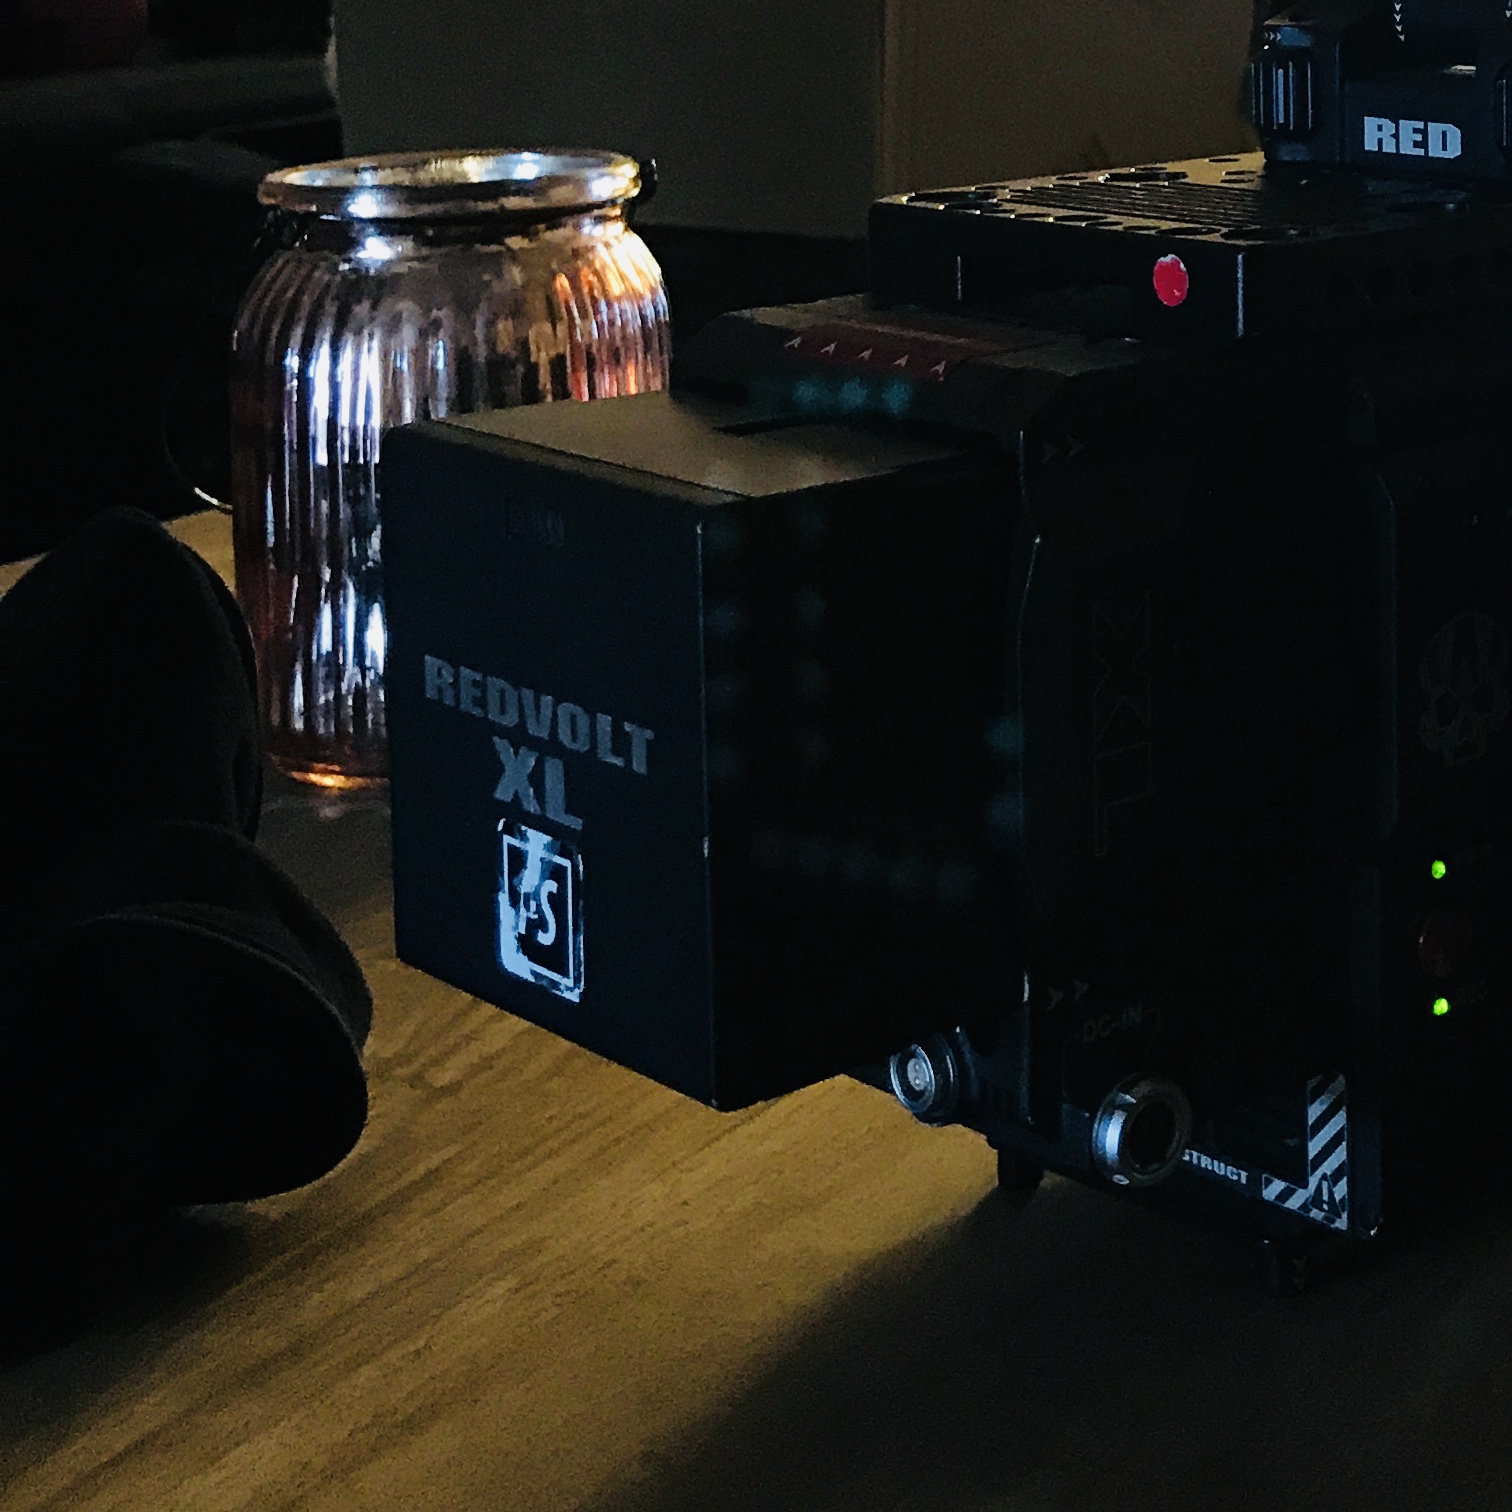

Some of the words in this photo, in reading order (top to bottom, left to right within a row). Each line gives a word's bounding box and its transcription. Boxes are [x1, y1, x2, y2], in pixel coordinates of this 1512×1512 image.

[1363, 116, 1462, 159] RED
[424, 654, 654, 776] REDVOLT
[493, 735, 584, 830] XL
